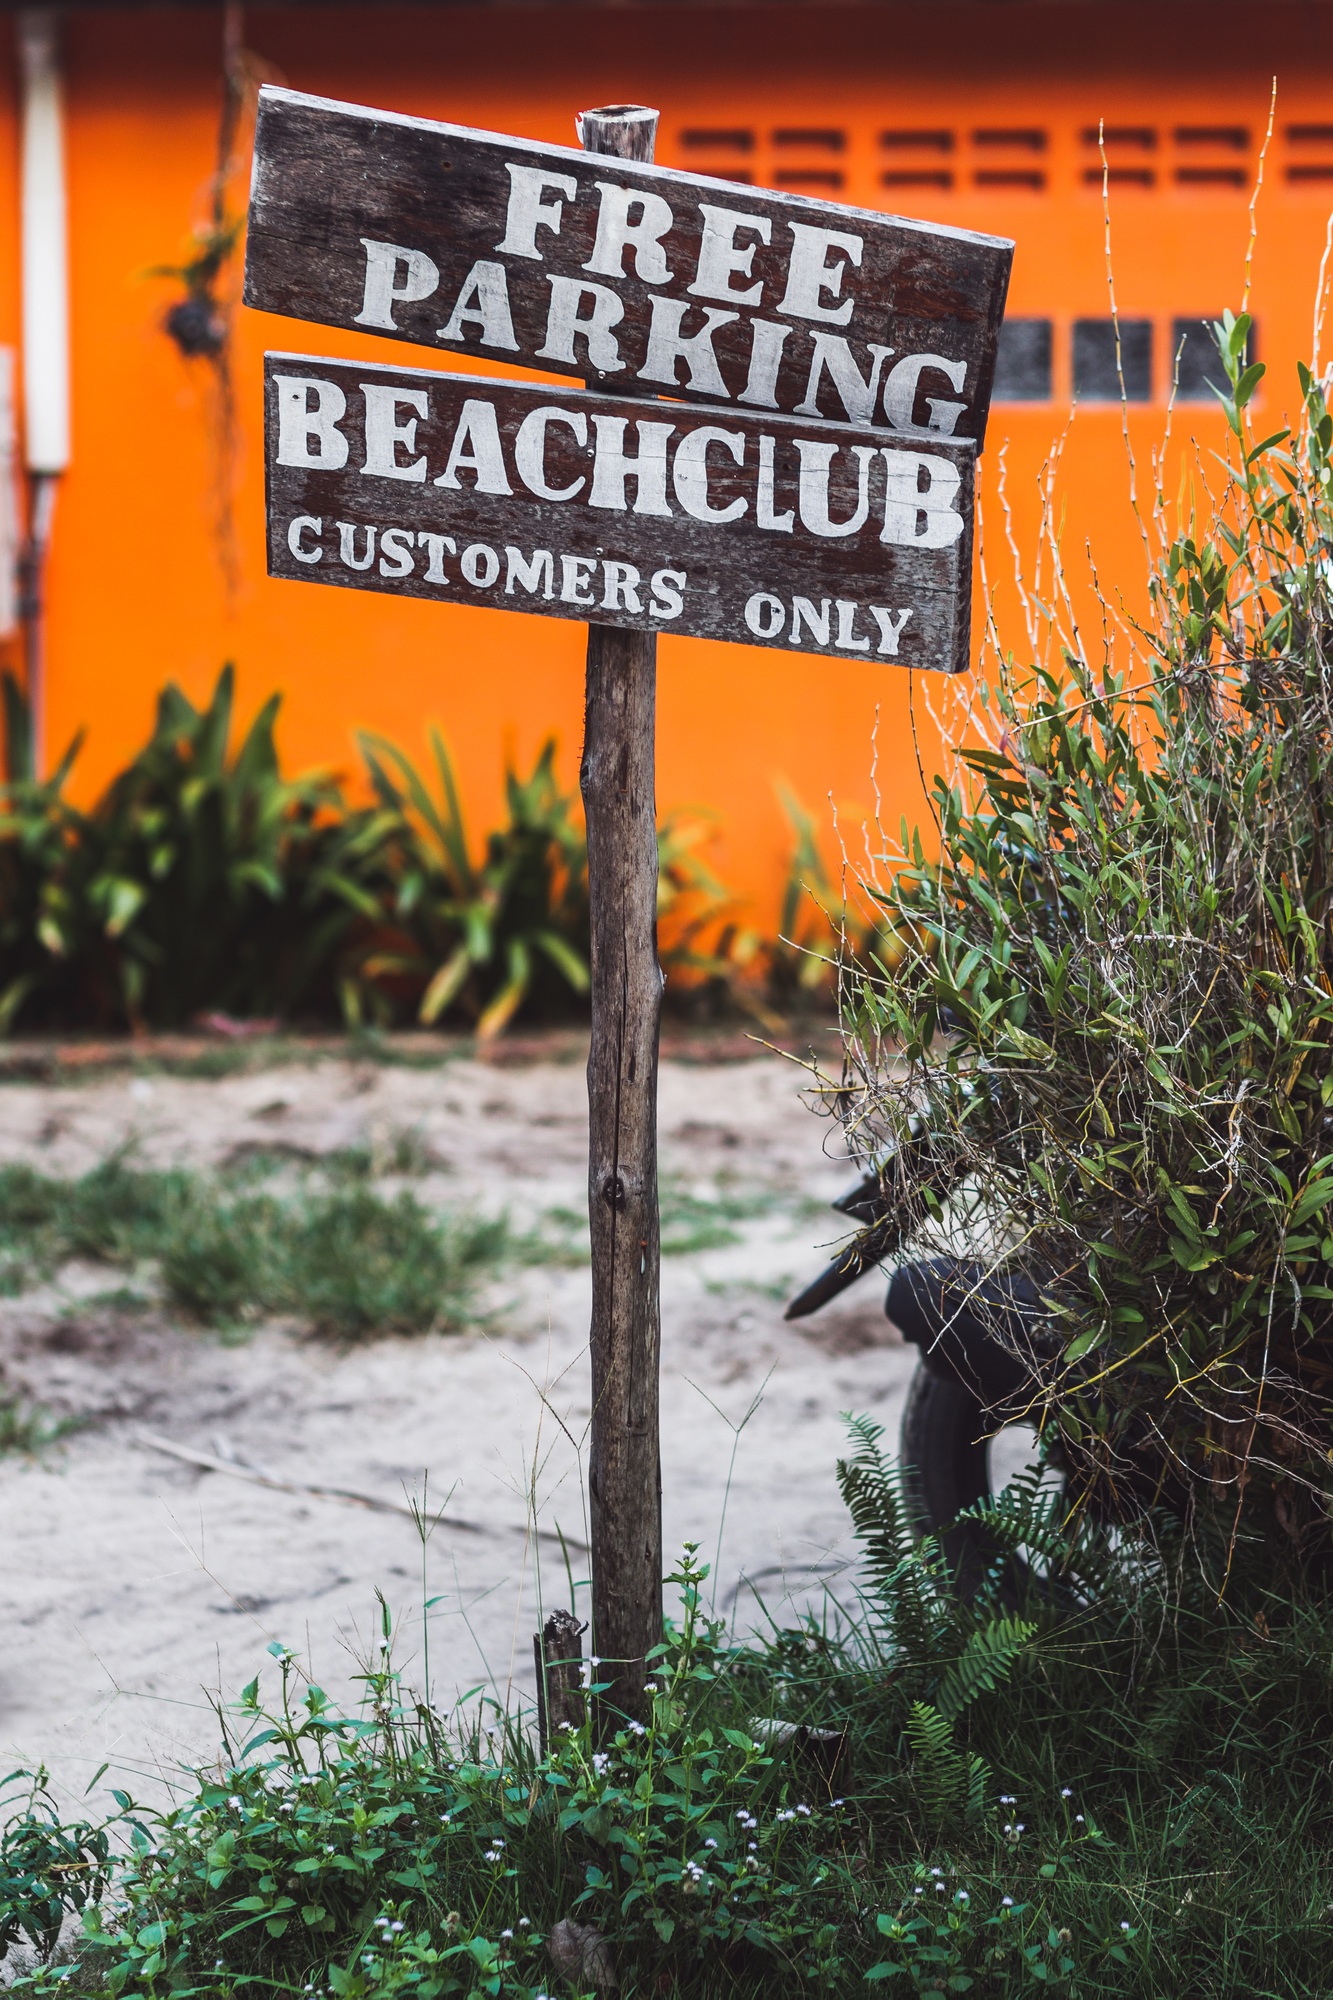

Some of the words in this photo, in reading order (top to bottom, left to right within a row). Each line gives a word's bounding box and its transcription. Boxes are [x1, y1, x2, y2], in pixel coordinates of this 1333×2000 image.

[494, 162, 864, 327] FREE
[353, 238, 969, 436] PARKING
[272, 373, 966, 550] BEACHCLUB
[287, 515, 688, 620] CUSTOMERS
[743, 592, 914, 657] ONLY
